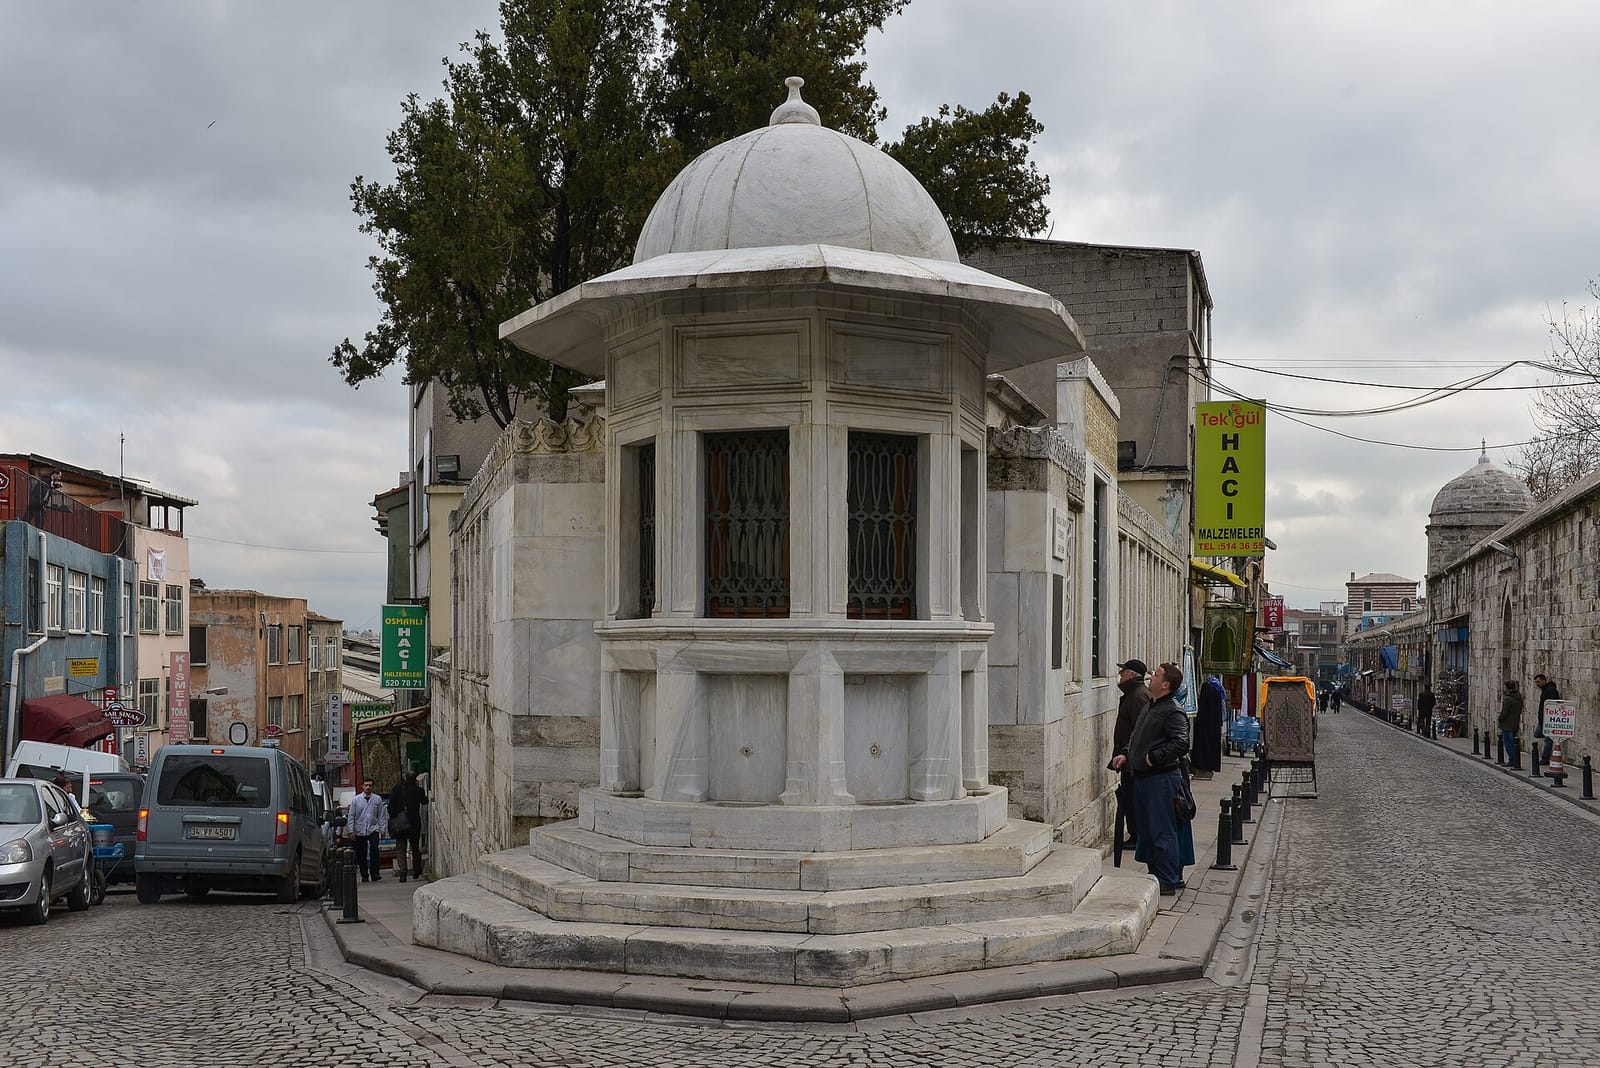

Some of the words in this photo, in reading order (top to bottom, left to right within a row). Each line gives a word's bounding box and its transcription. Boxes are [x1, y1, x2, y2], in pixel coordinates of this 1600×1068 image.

[1221, 433, 1240, 520] HACI
[1199, 525, 1264, 540] MALZEMELERİ
[1198, 542, 1215, 551] TEL
[1239, 542, 1251, 551] 36
[1252, 541, 1264, 550] 55
[385, 617, 423, 626] OSMANLI
[397, 627, 411, 670] HACI
[174, 654, 186, 707] KISMET
[385, 679, 400, 687] 520
[401, 679, 411, 687] 78
[413, 679, 422, 687] 71
[171, 707, 188, 717] TOKA
[191, 827, 200, 837] 34
[203, 827, 212, 837] VY
[215, 828, 233, 838] 4501
